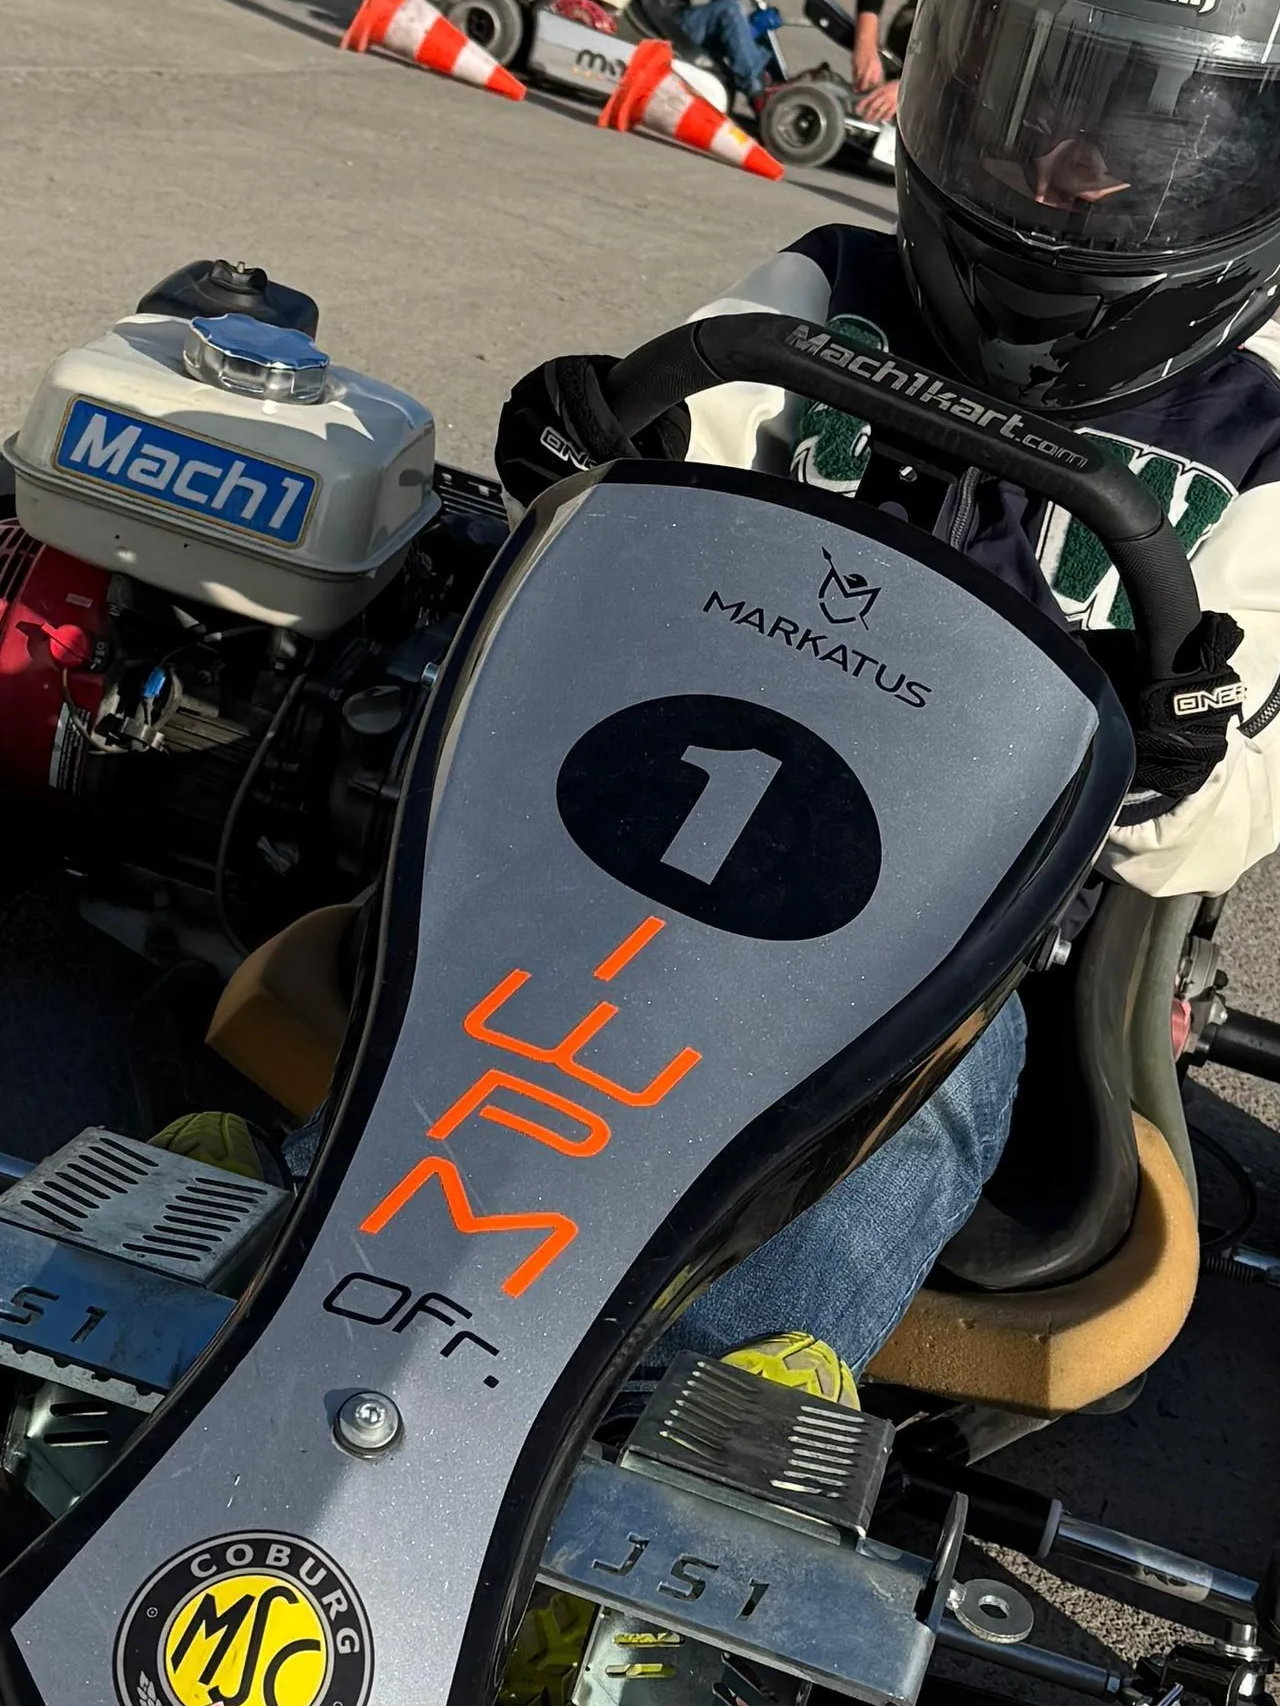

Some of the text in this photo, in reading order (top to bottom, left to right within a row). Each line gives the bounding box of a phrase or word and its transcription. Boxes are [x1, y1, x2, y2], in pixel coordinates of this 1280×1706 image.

[70, 412, 304, 531] Mach1
[702, 590, 933, 709] MARKATUS
[660, 745, 783, 886] 1
[189, 1542, 361, 1657] COBURG
